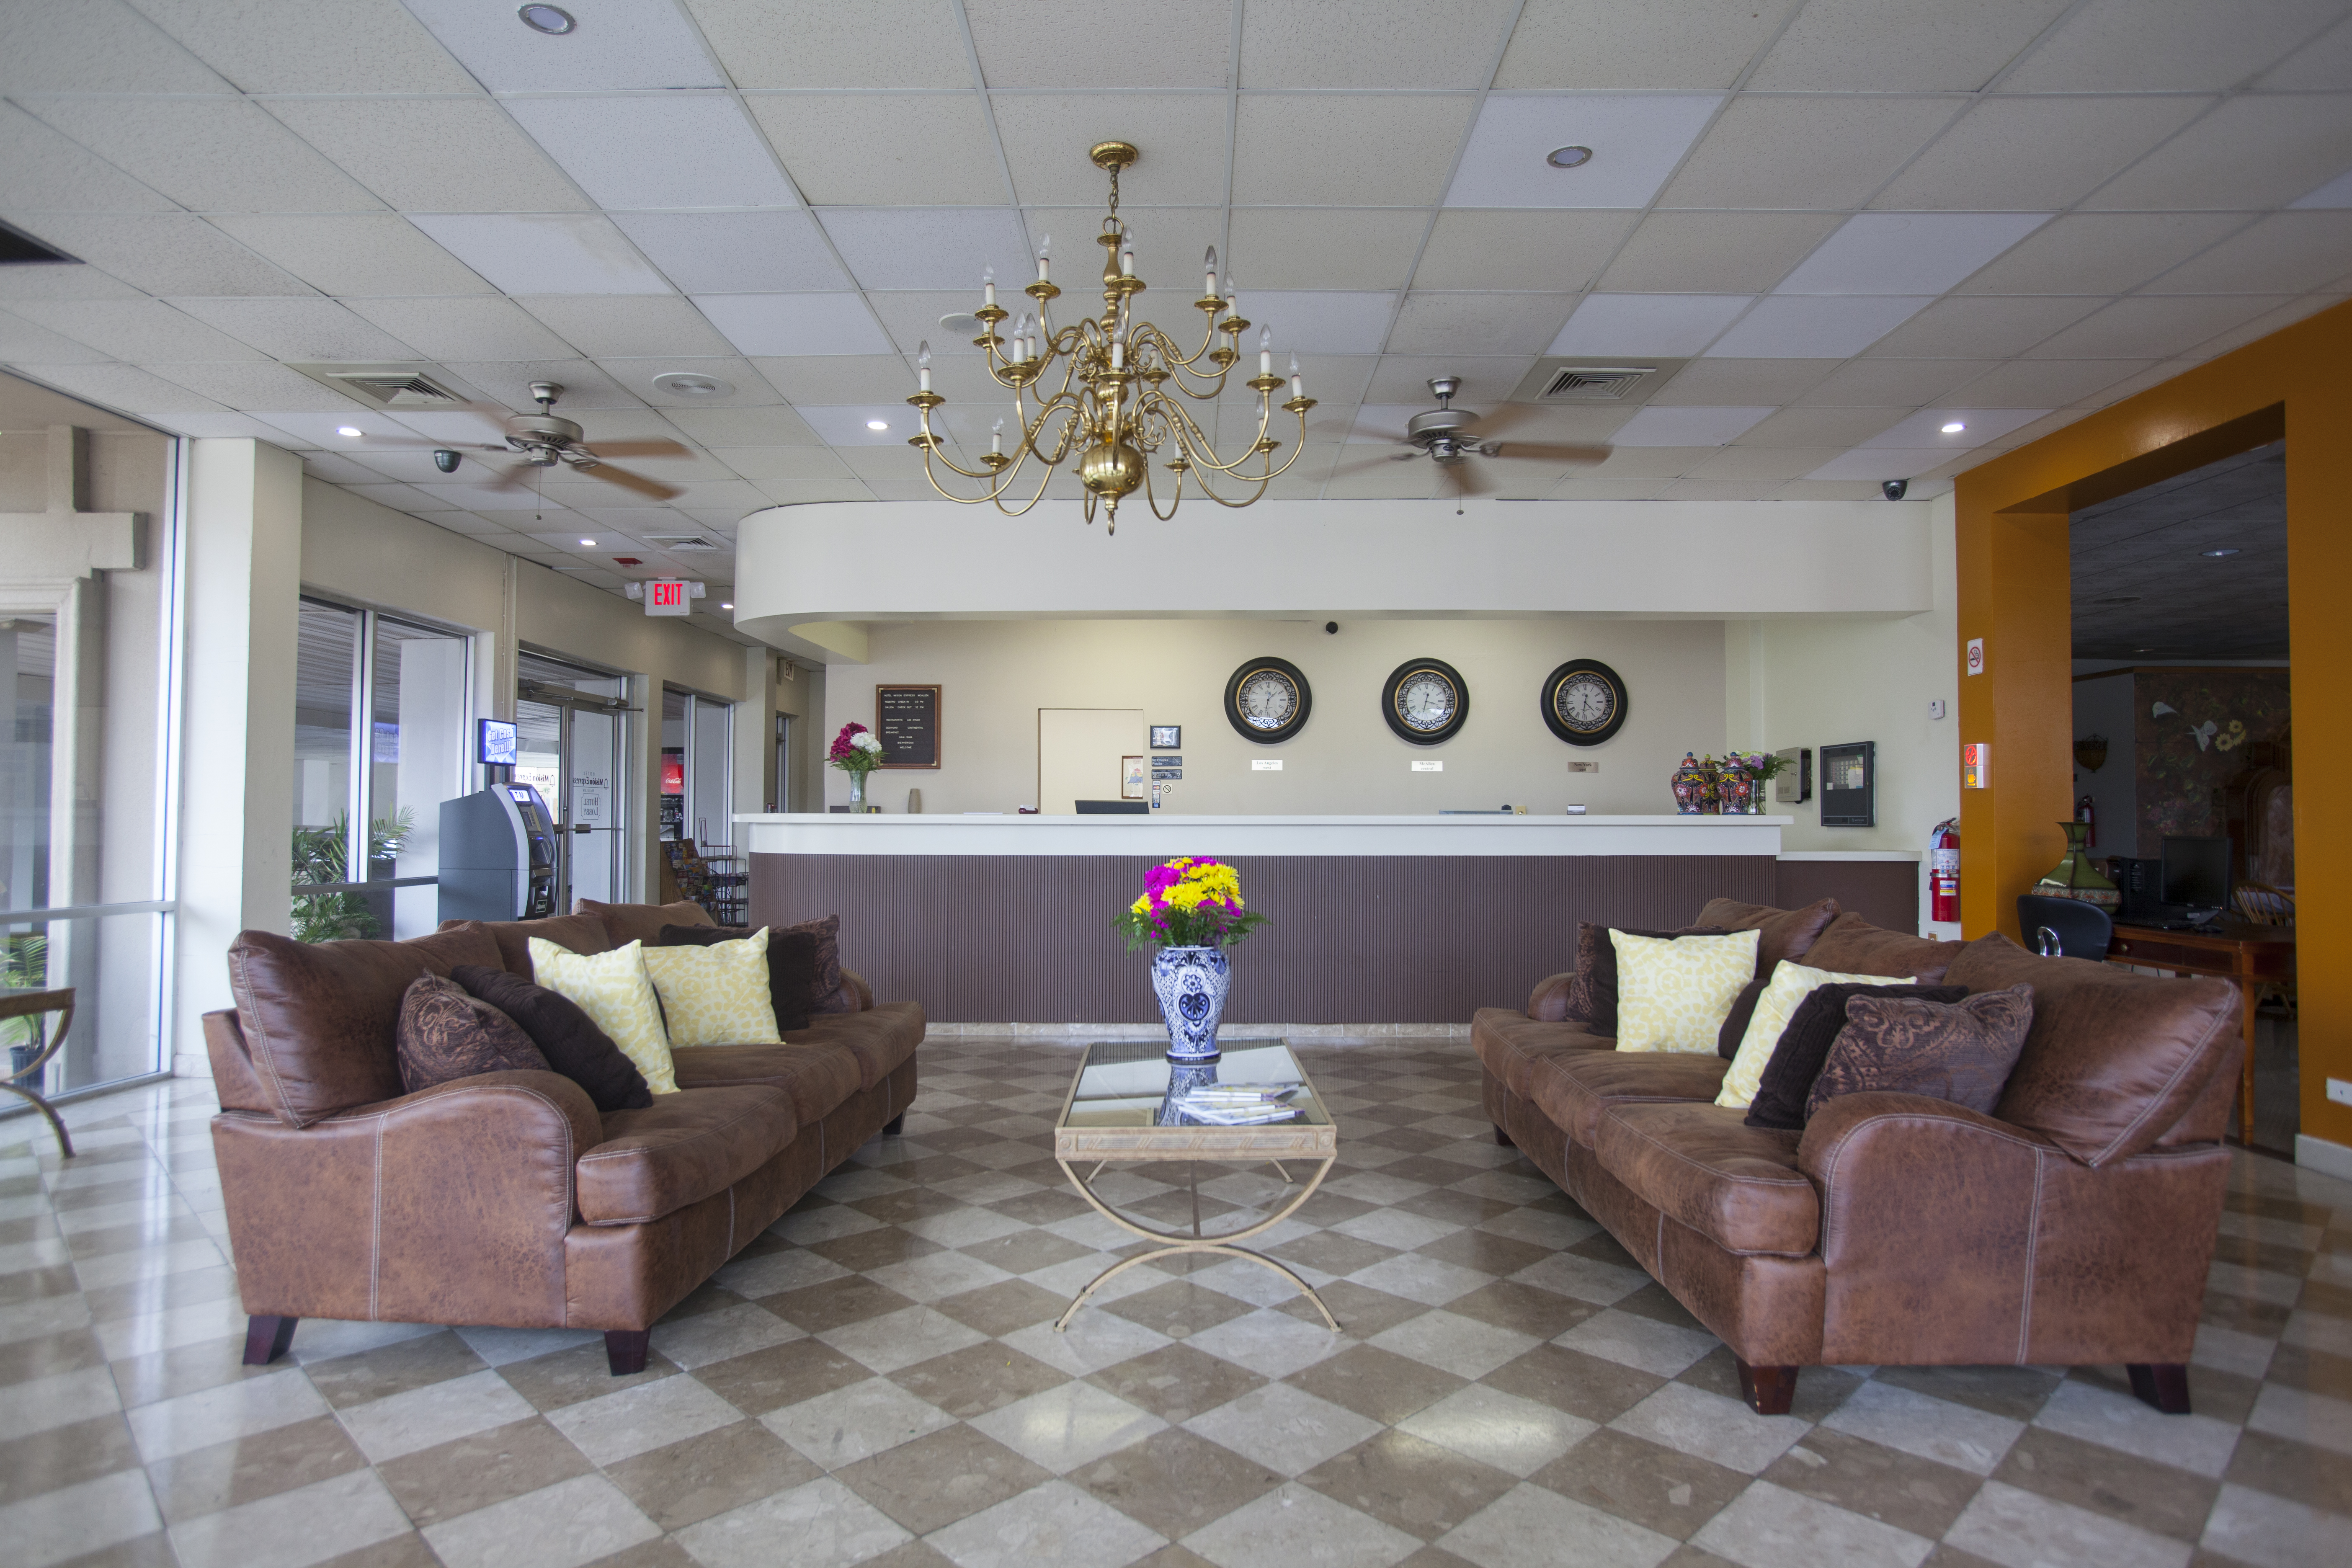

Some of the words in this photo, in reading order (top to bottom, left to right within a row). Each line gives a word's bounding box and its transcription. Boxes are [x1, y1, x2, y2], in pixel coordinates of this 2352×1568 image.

[655, 583, 683, 605] EXIT
[488, 729, 498, 742] Get
[500, 726, 514, 740] Cash
[491, 740, 511, 755] Here!!!
